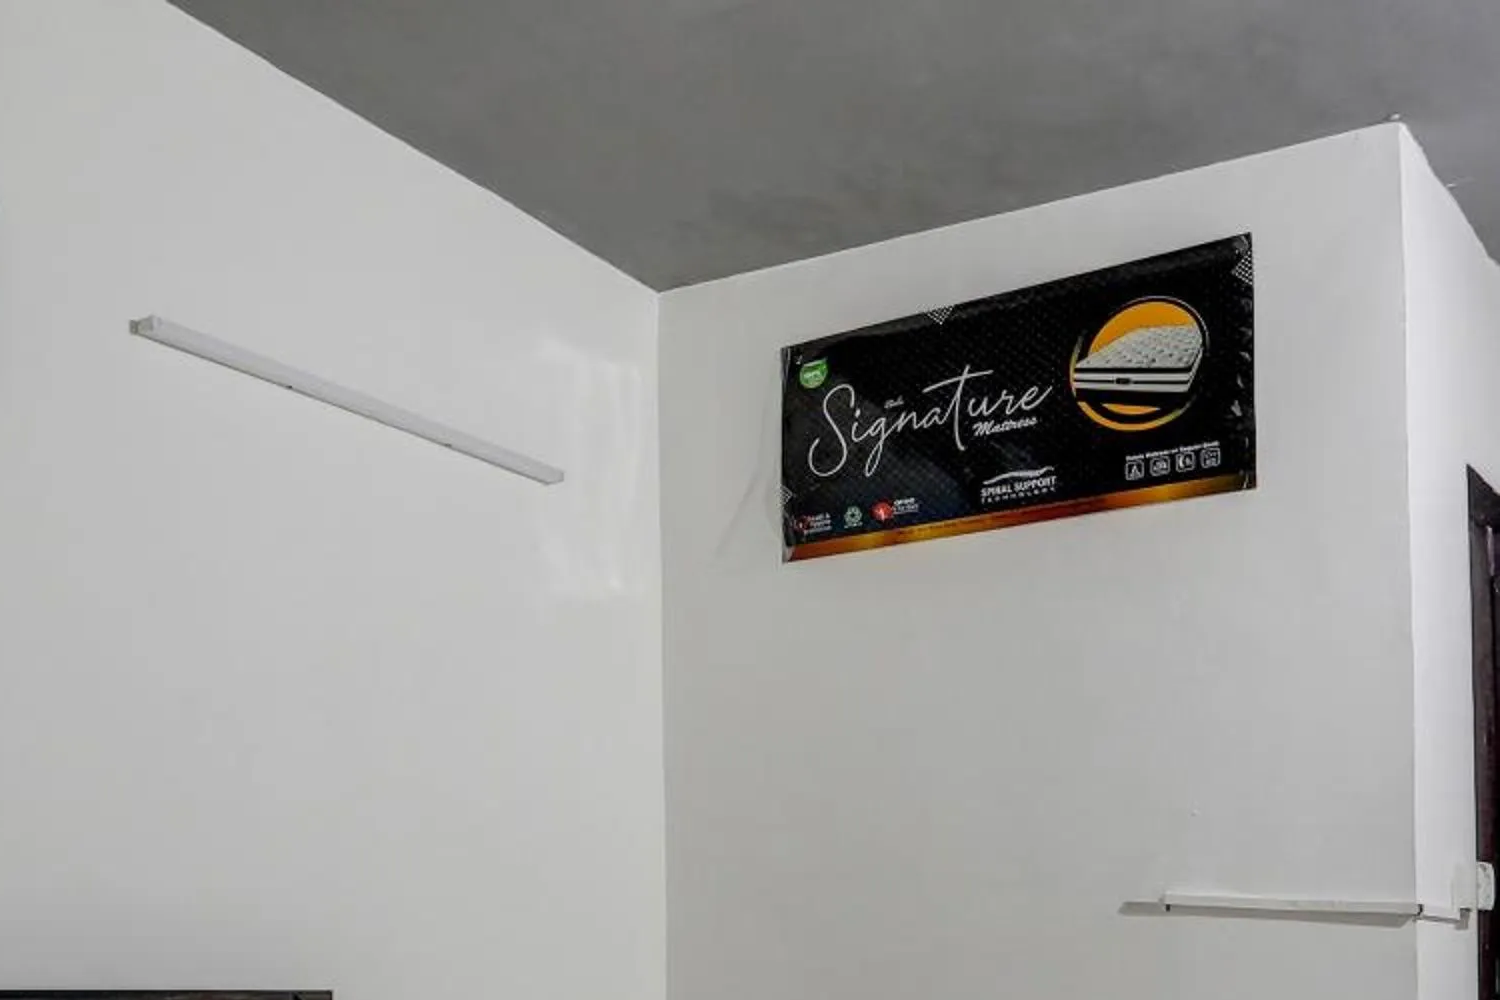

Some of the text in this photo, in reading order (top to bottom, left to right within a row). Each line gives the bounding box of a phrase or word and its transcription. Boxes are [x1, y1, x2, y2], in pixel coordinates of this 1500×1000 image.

[808, 363, 1053, 478] Signature
[972, 416, 1038, 436] Mattress
[1013, 476, 1057, 492] SUPPORT
